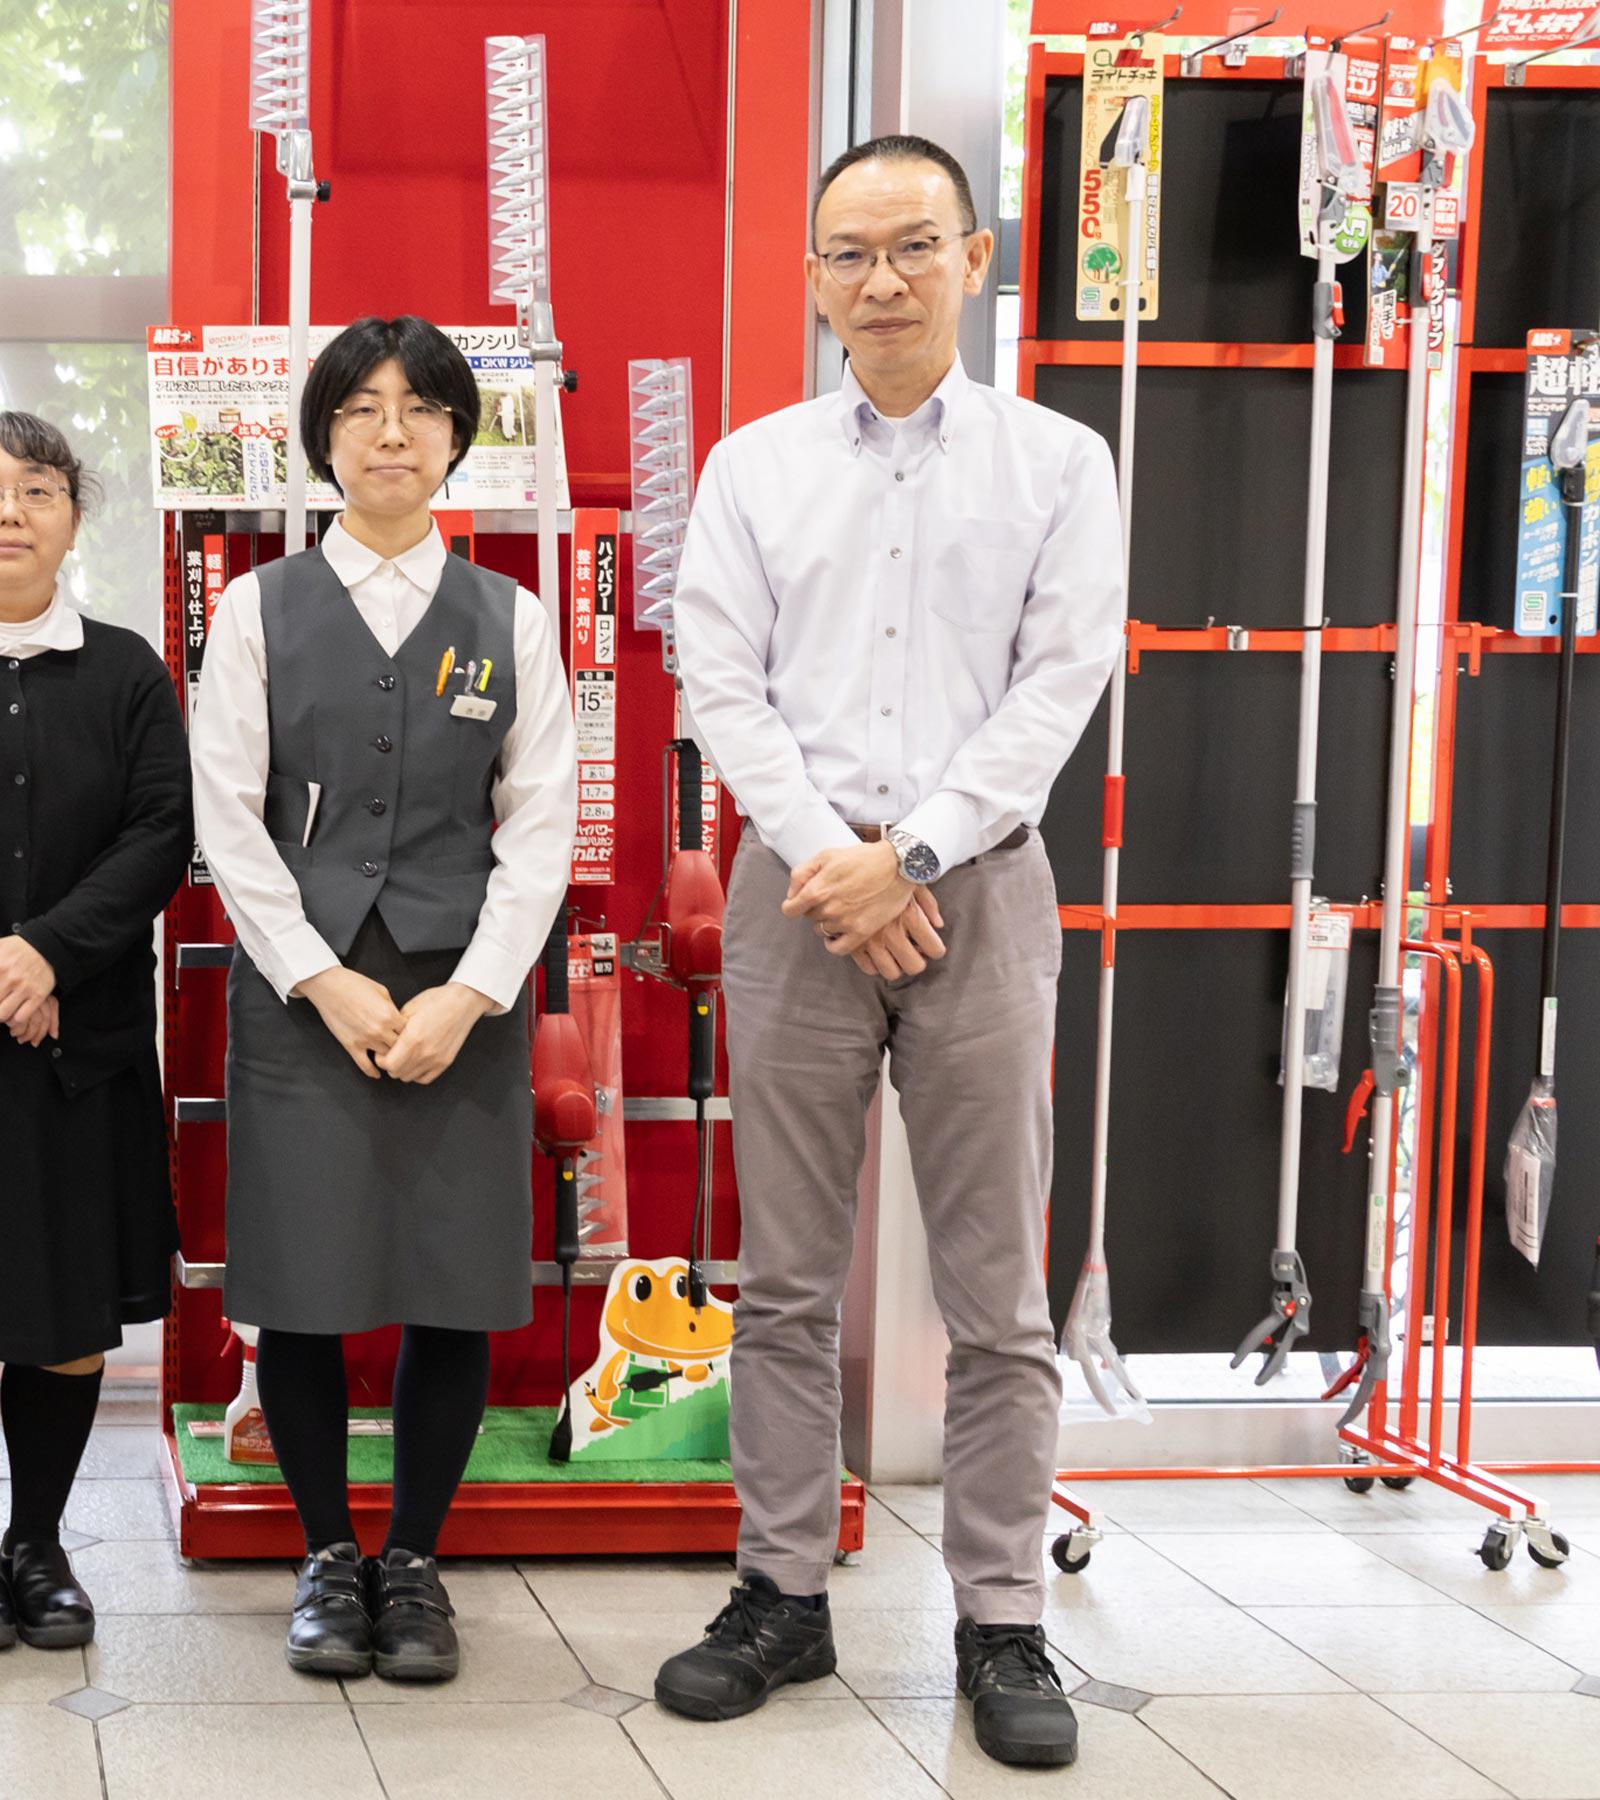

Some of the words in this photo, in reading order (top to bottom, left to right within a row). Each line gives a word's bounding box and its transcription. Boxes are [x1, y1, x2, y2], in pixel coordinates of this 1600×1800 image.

[1389, 195, 1417, 218] 20
[153, 329, 180, 344] ARS
[154, 357, 290, 377] 自信がありま
[597, 541, 613, 612] ハイパワー
[187, 551, 204, 648] 葉刈り仕上げ
[576, 549, 591, 645] 整枝・葉刈り
[599, 620, 610, 659] ロング
[578, 692, 601, 712] 15
